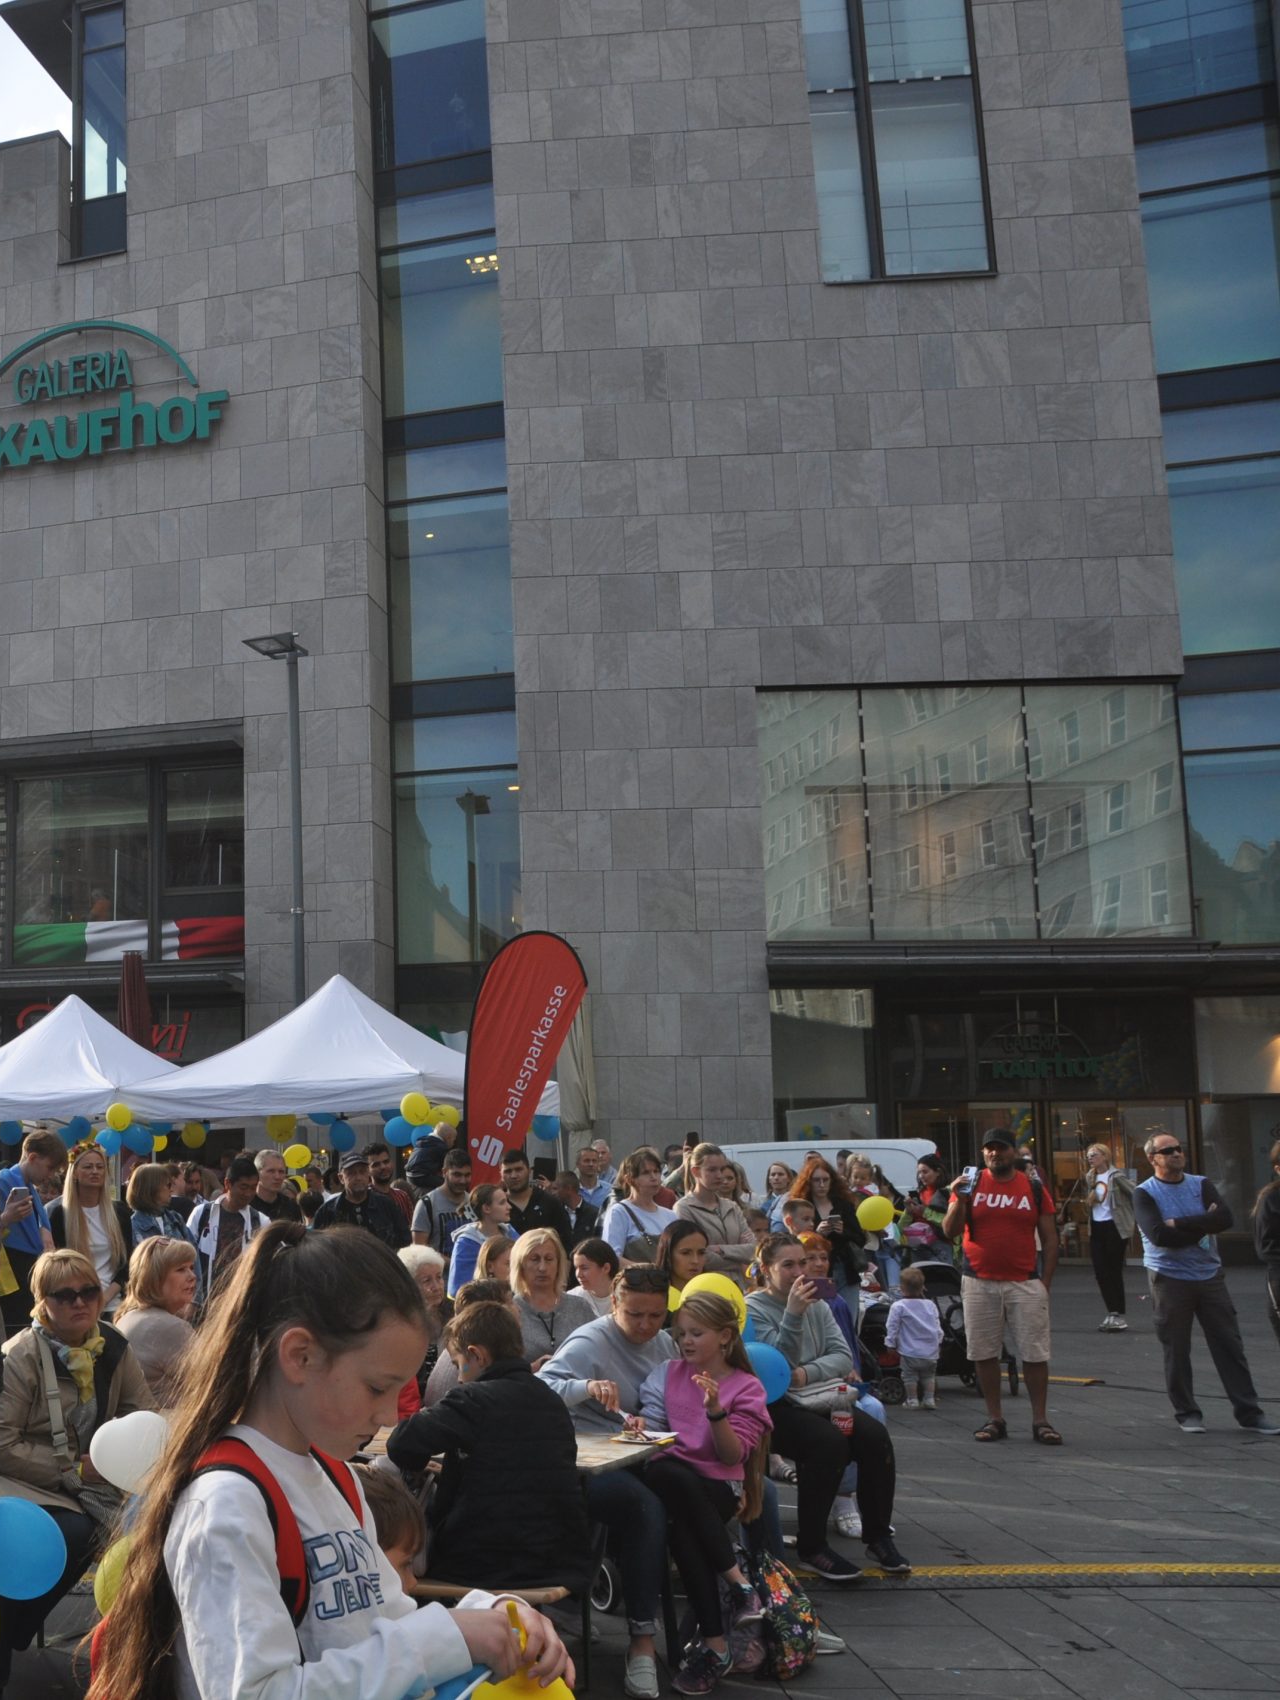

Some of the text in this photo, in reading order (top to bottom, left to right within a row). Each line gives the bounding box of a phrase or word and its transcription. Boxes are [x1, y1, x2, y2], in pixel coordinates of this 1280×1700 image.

[14, 348, 135, 404] GALERIA
[496, 985, 568, 1132] Saalesparkasse
[973, 1192, 1032, 1211] PUMA
